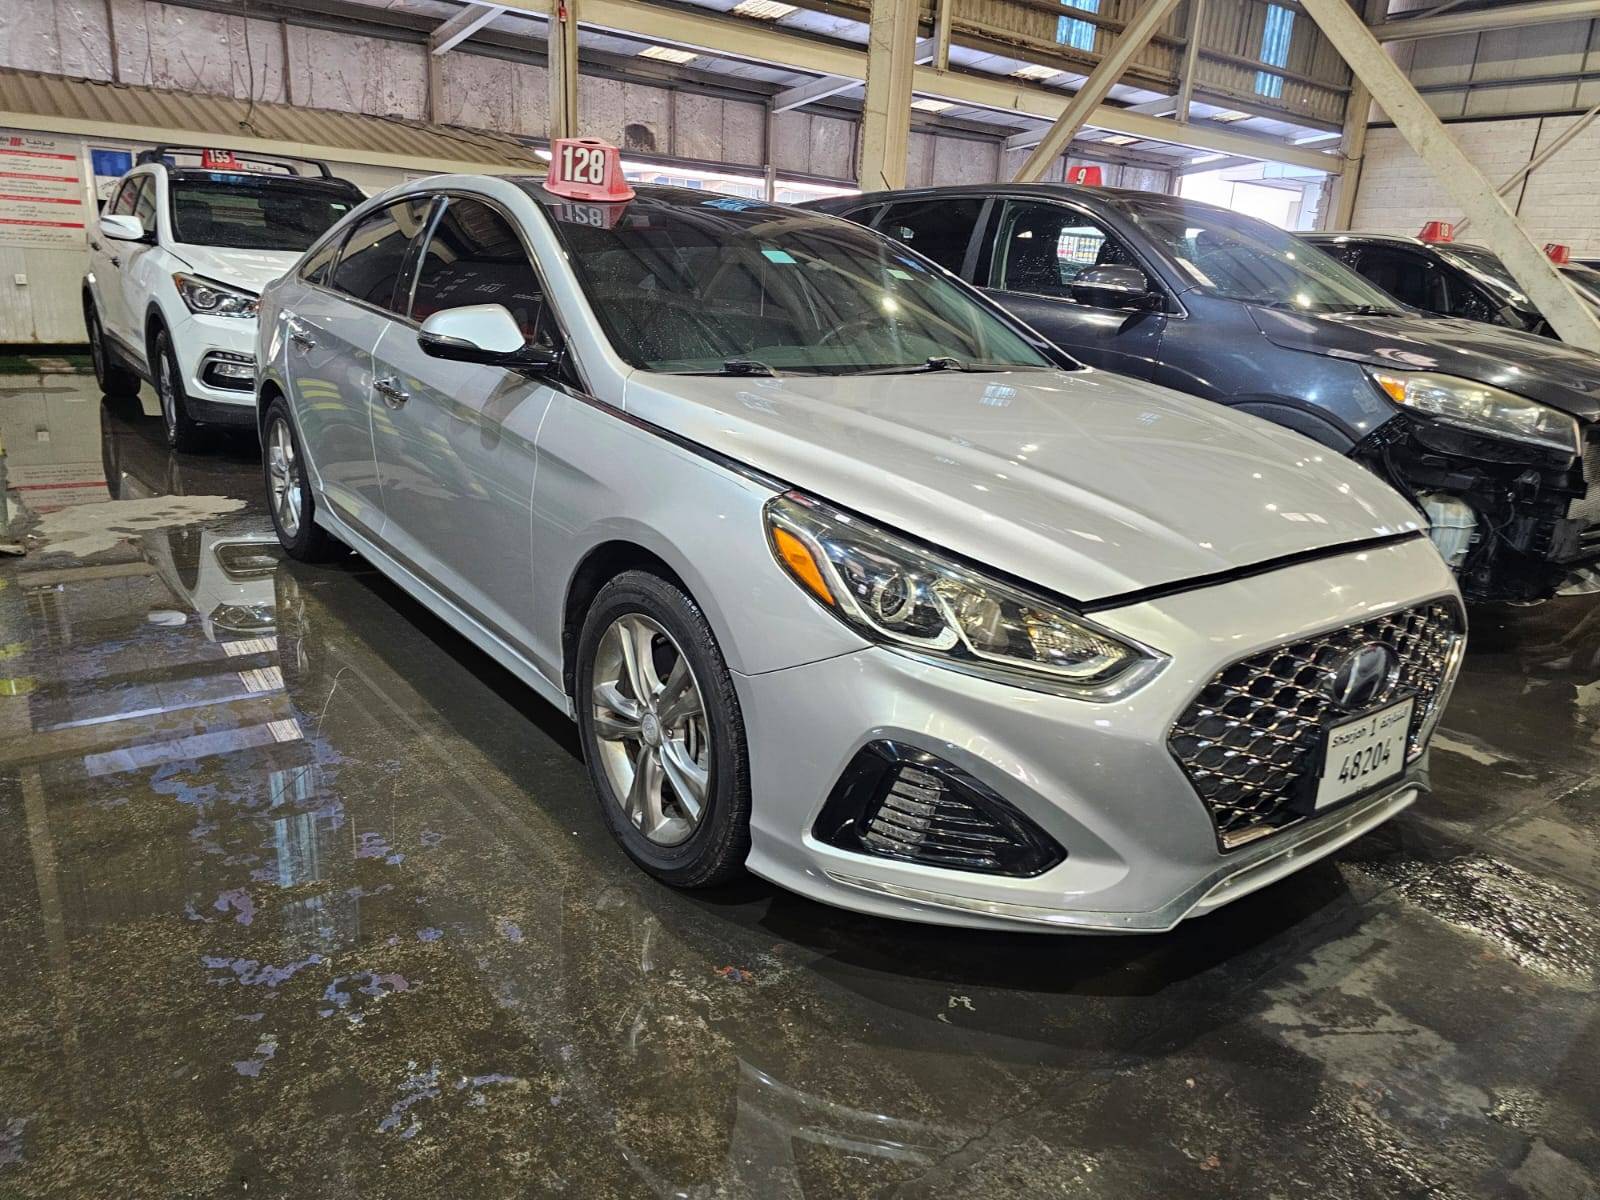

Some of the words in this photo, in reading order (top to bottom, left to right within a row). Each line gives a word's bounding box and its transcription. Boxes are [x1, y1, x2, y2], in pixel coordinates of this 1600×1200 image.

[208, 150, 230, 163] 155
[563, 146, 605, 184] 128
[1076, 168, 1087, 185] 9
[1332, 727, 1367, 748] Sharjah
[1338, 738, 1392, 784] 48204
